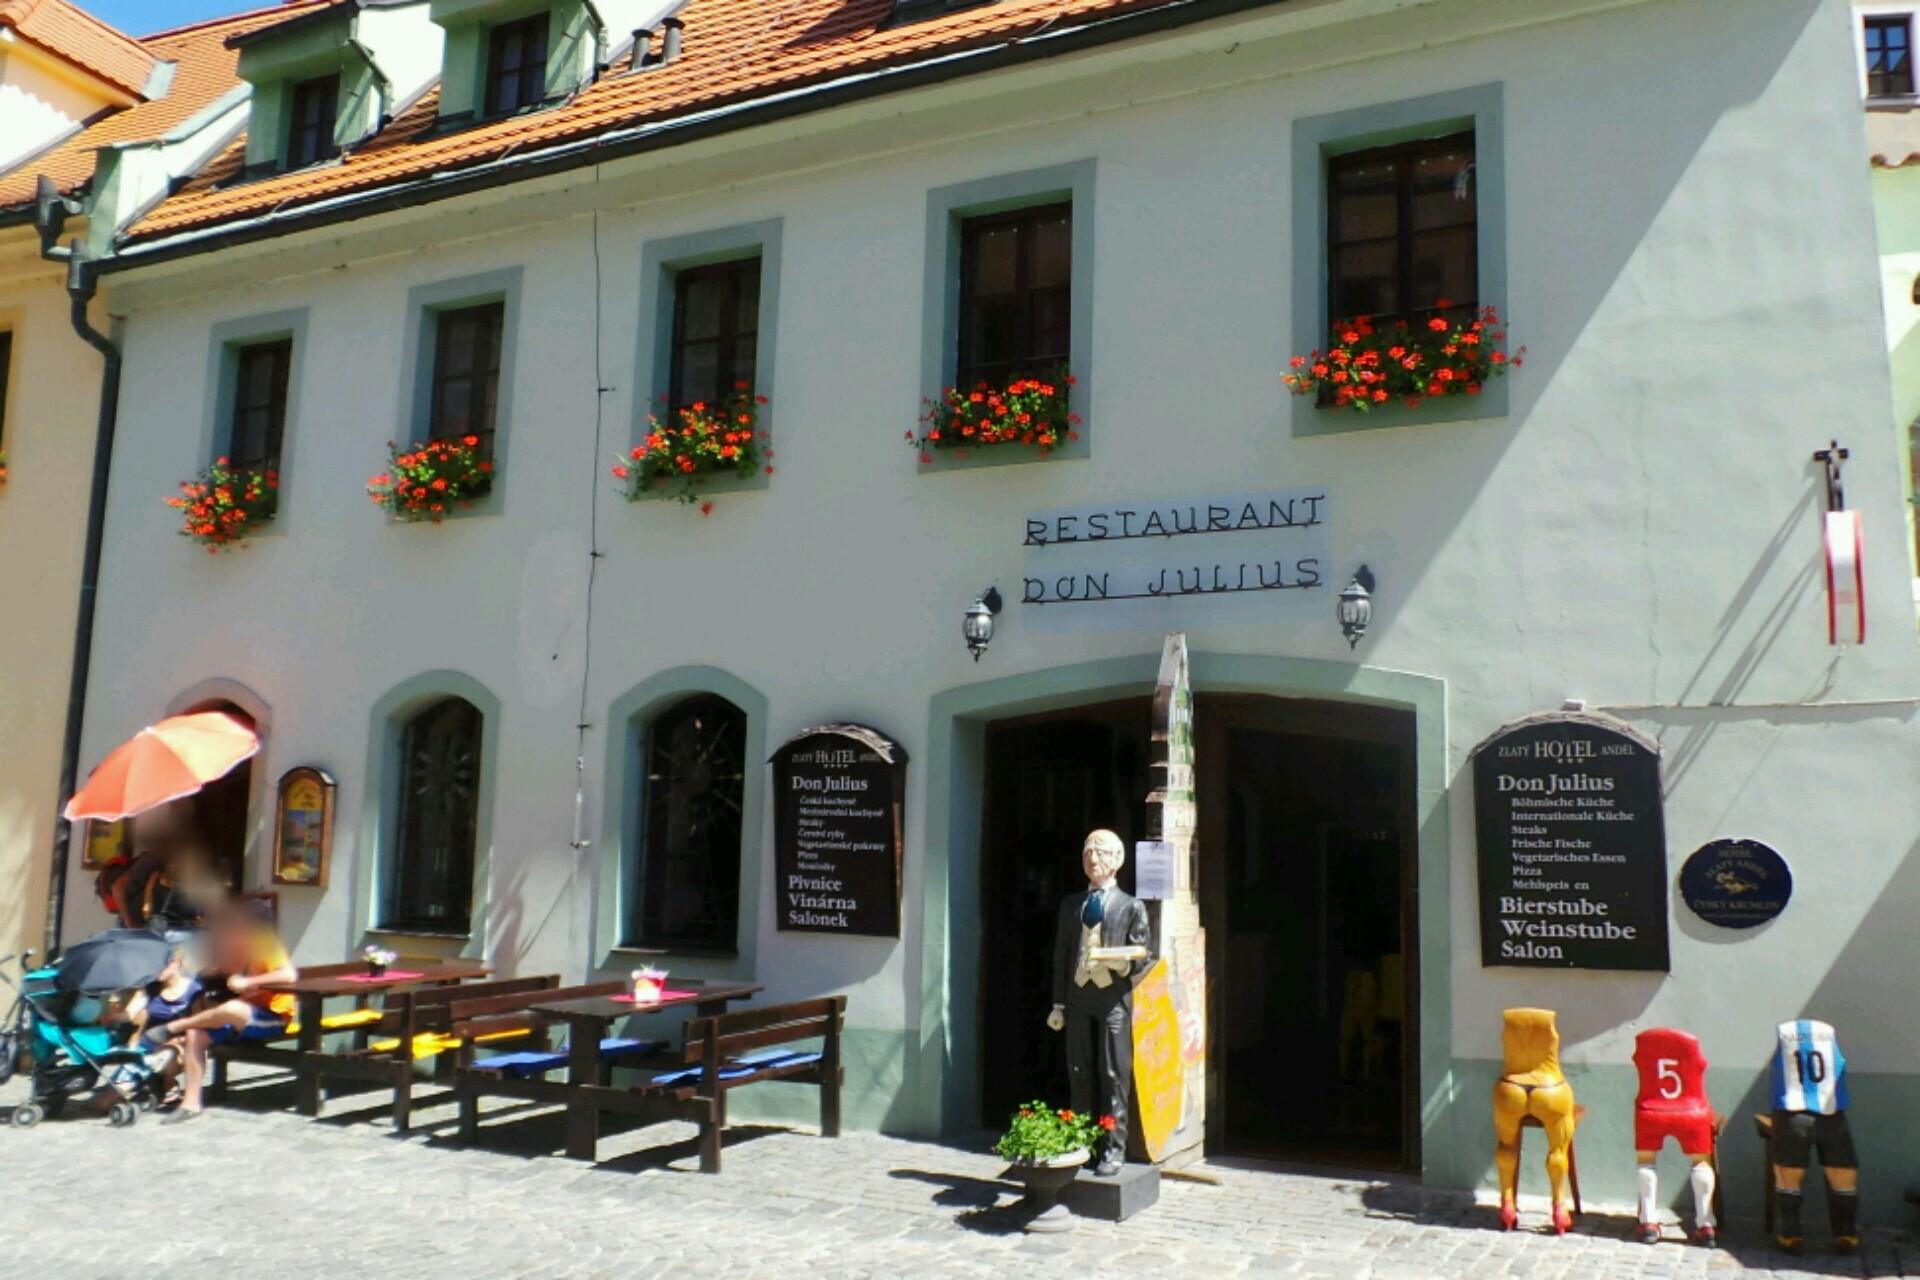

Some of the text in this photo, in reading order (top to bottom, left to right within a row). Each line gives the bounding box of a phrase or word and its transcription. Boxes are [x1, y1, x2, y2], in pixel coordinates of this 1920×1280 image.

[1025, 494, 1326, 546] RESTAURANT
[1023, 558, 1321, 602] DON JULIUS
[815, 749, 856, 763] HOTEL
[1534, 740, 1597, 758] HOTEL
[792, 776, 868, 793] Don Julius
[1497, 773, 1615, 795] Don Julius
[1511, 797, 1615, 807] Böhmische Küche
[1511, 811, 1635, 821] Internationale Küche
[1511, 825, 1548, 835] Steaks
[1512, 838, 1592, 848] Frische Fische
[1512, 851, 1627, 864] Vegetarisches Essen
[1512, 865, 1543, 876] Pizza
[788, 875, 842, 891] Pivnice
[788, 893, 857, 910] Vinárna
[1500, 896, 1609, 915] Bierstube
[789, 910, 848, 928] Salonek
[1501, 919, 1637, 939] Weinstube
[1501, 940, 1563, 959] Salon
[1792, 1050, 1825, 1085] 10
[1657, 1058, 1683, 1099] 5
